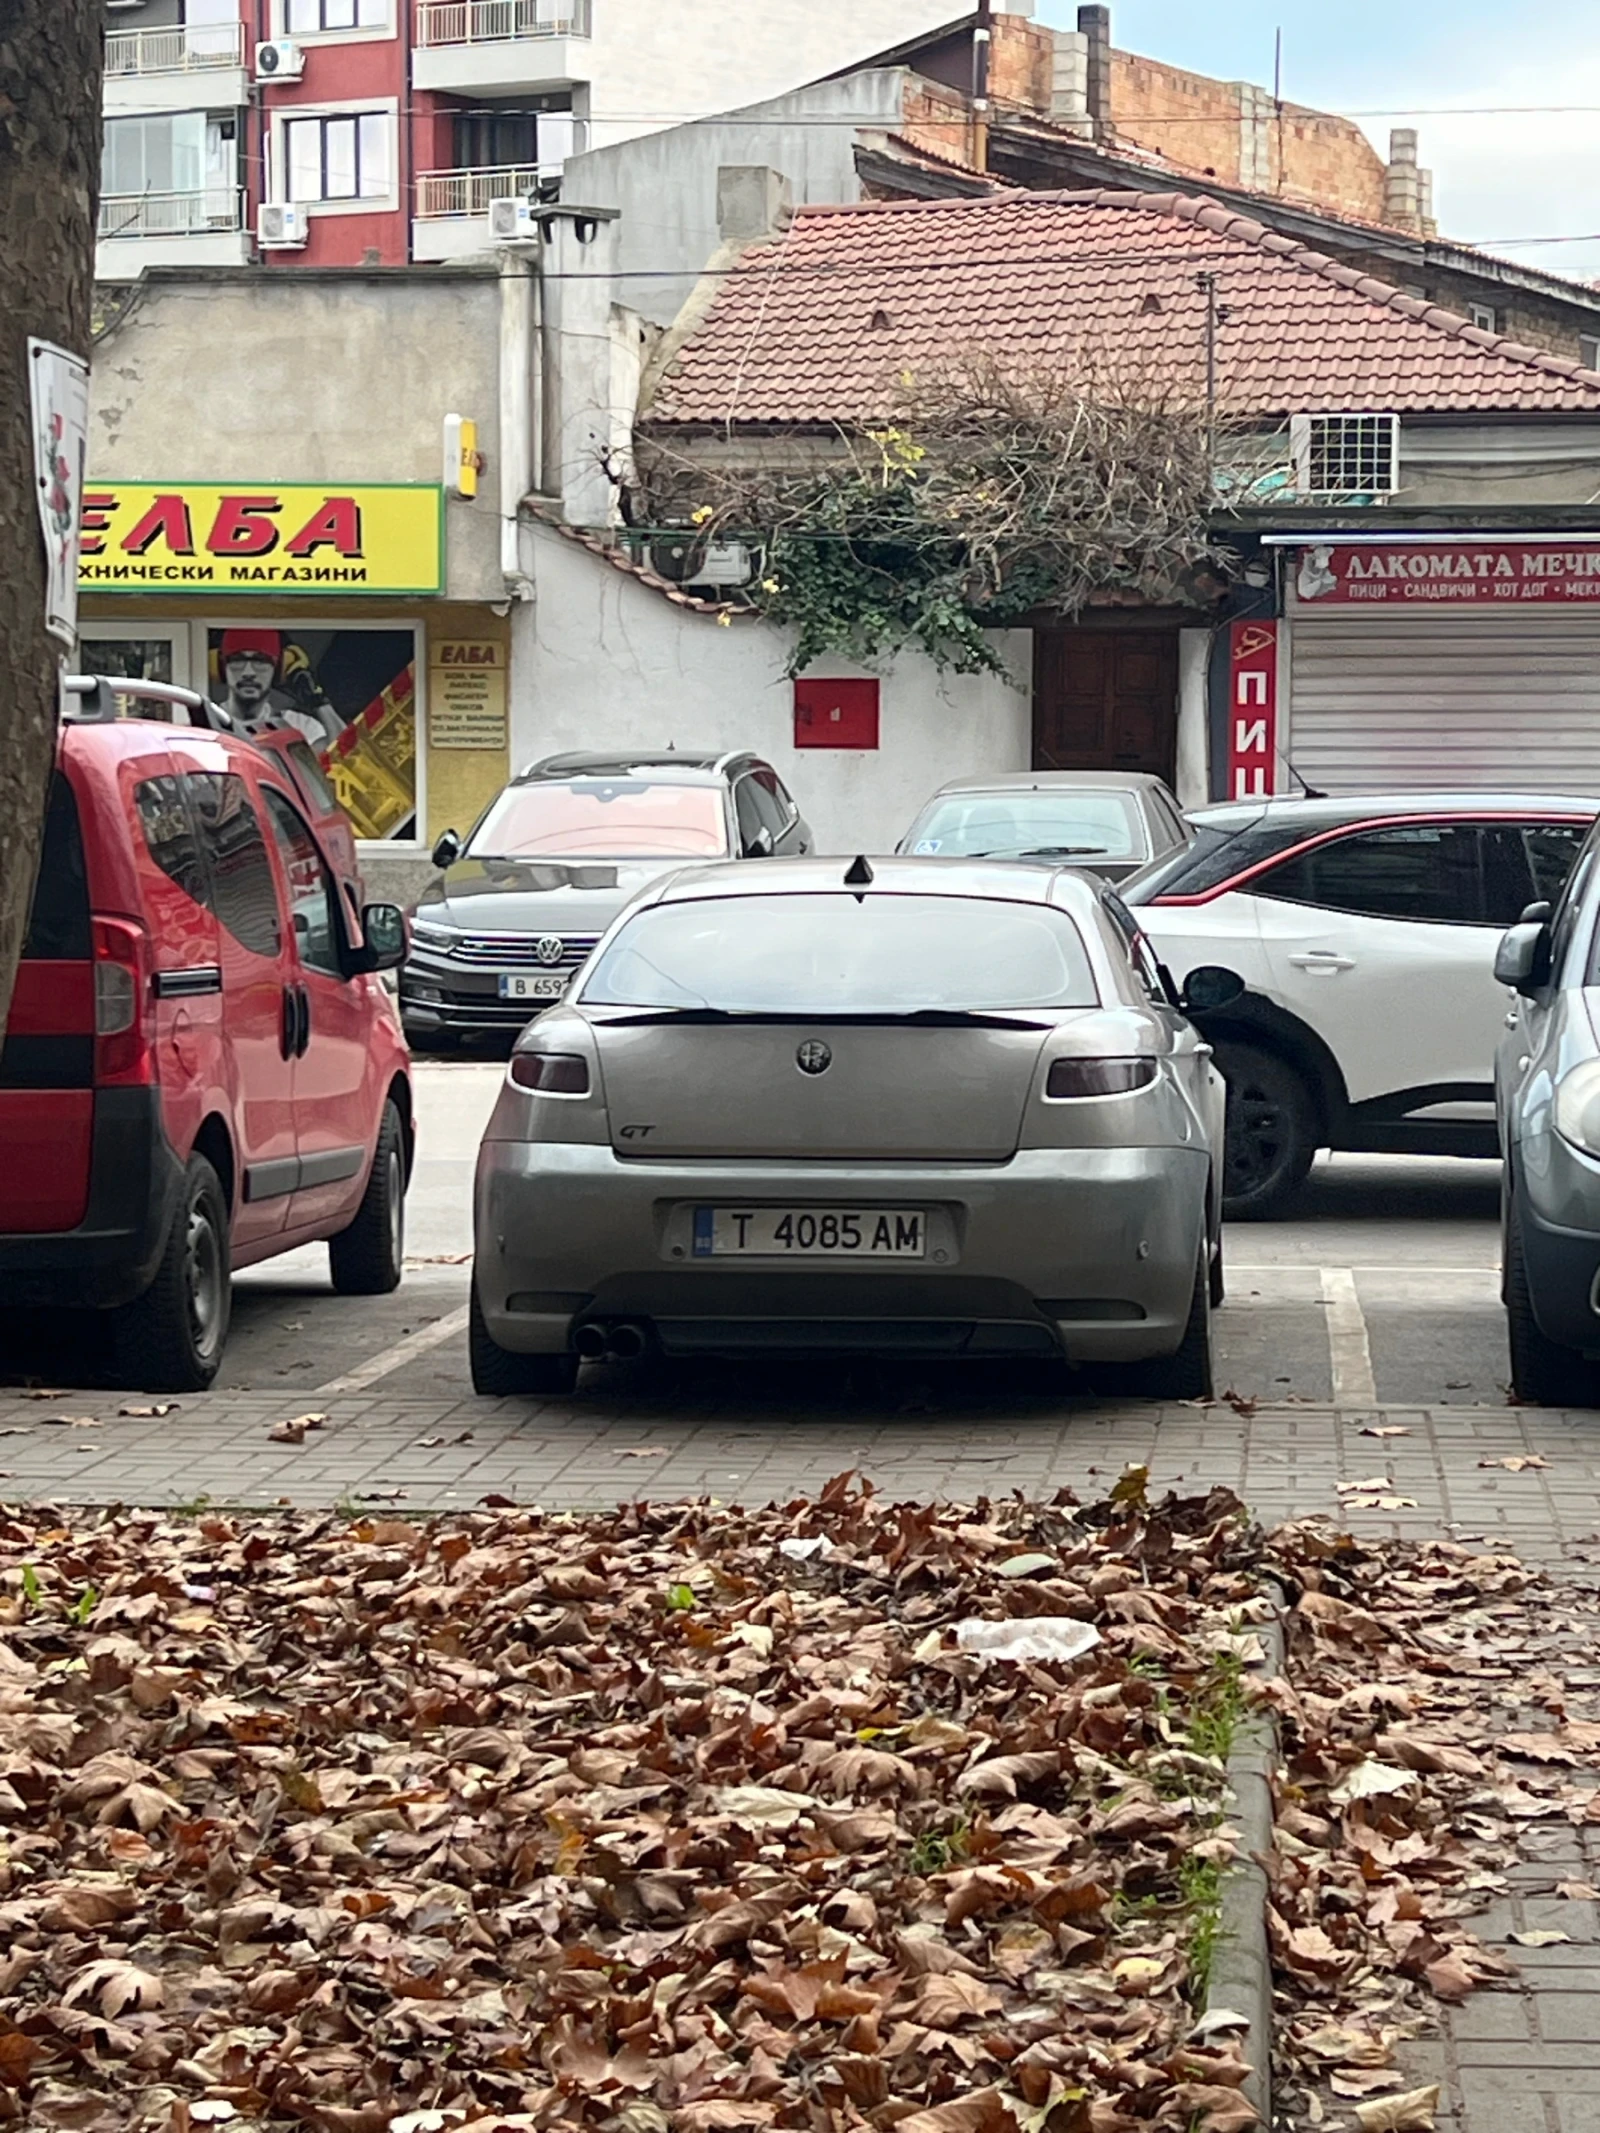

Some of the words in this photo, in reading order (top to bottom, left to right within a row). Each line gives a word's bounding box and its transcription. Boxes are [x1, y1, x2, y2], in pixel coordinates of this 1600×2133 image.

[230, 566, 367, 581] МАГАЗИНИ
[1345, 554, 1514, 578] ЛАКОМАТА
[1349, 584, 1387, 599] ПИЦИ
[1404, 583, 1476, 599] САНДВИЧИ
[1494, 582, 1519, 597] ХОТ
[1521, 581, 1548, 598] ДОГ
[440, 645, 496, 664] ЕЛБА
[515, 979, 526, 995] B
[534, 979, 568, 995] 659
[620, 1125, 656, 1139] GT
[732, 1214, 753, 1248] T
[774, 1214, 861, 1249] 4085
[872, 1215, 918, 1250] AM
